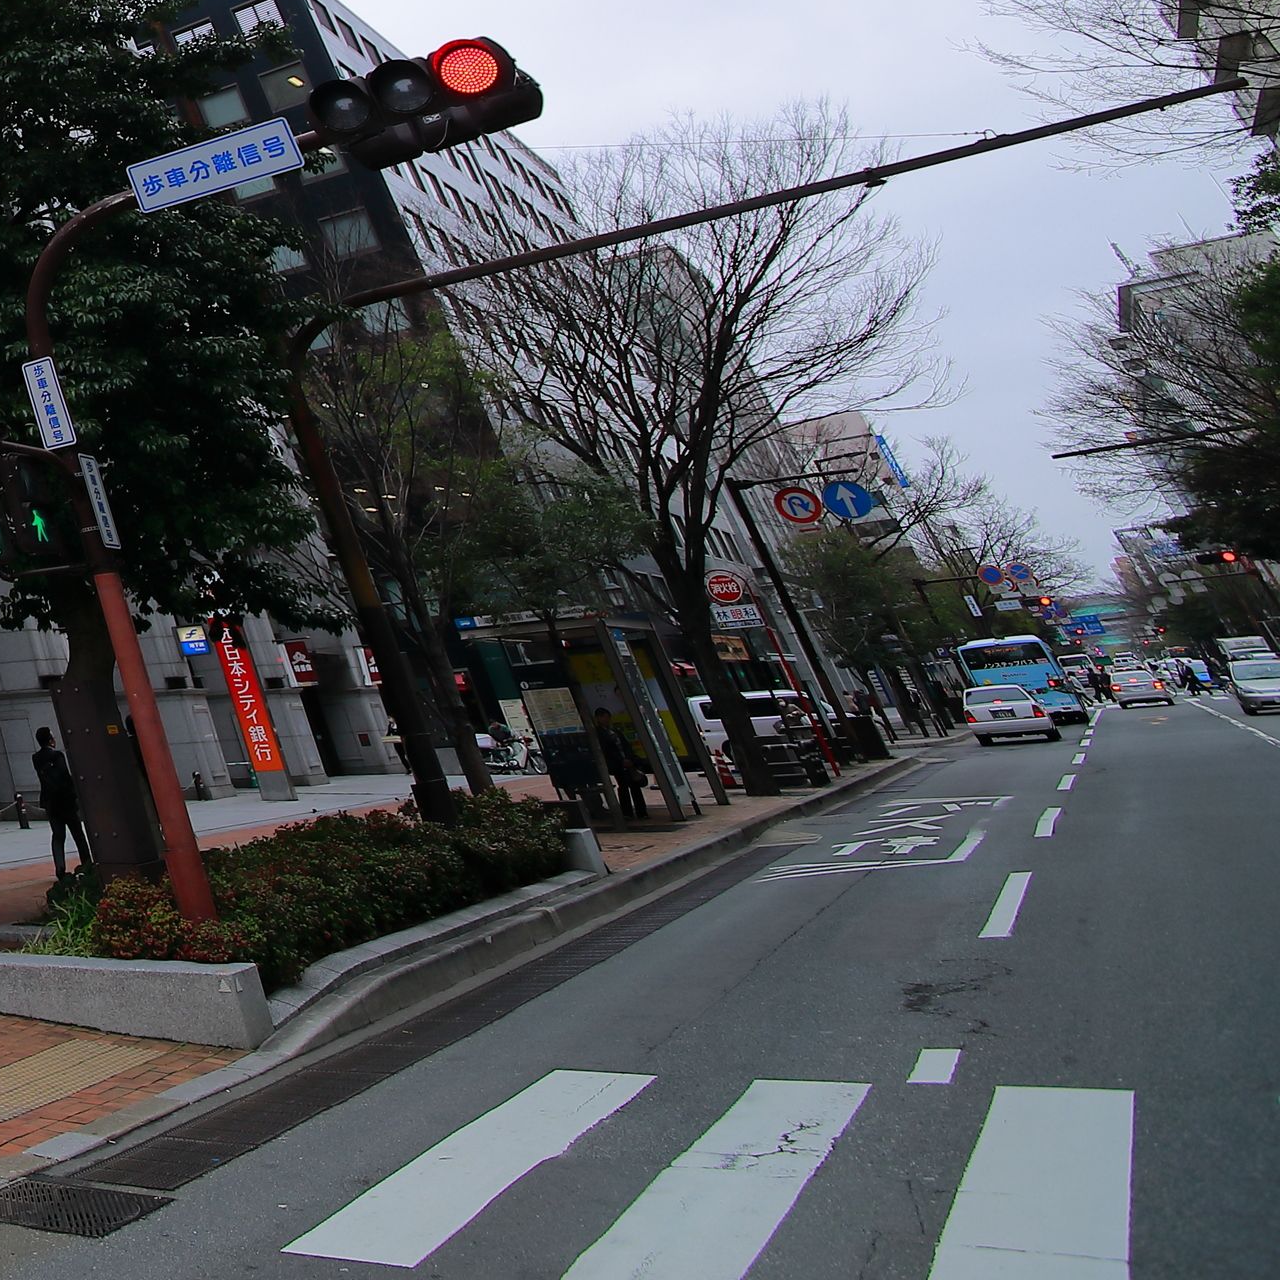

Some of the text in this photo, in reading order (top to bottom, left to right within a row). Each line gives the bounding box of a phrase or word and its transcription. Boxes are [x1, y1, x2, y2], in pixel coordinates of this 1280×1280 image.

[142, 135, 285, 197] 歩車分離信号
[33, 365, 64, 443] 歩車分離信号
[86, 461, 115, 543] 歩車分離信号
[710, 582, 740, 594] 消火栓
[716, 607, 757, 621] 林眼科
[984, 659, 1036, 669] ノンステップバス
